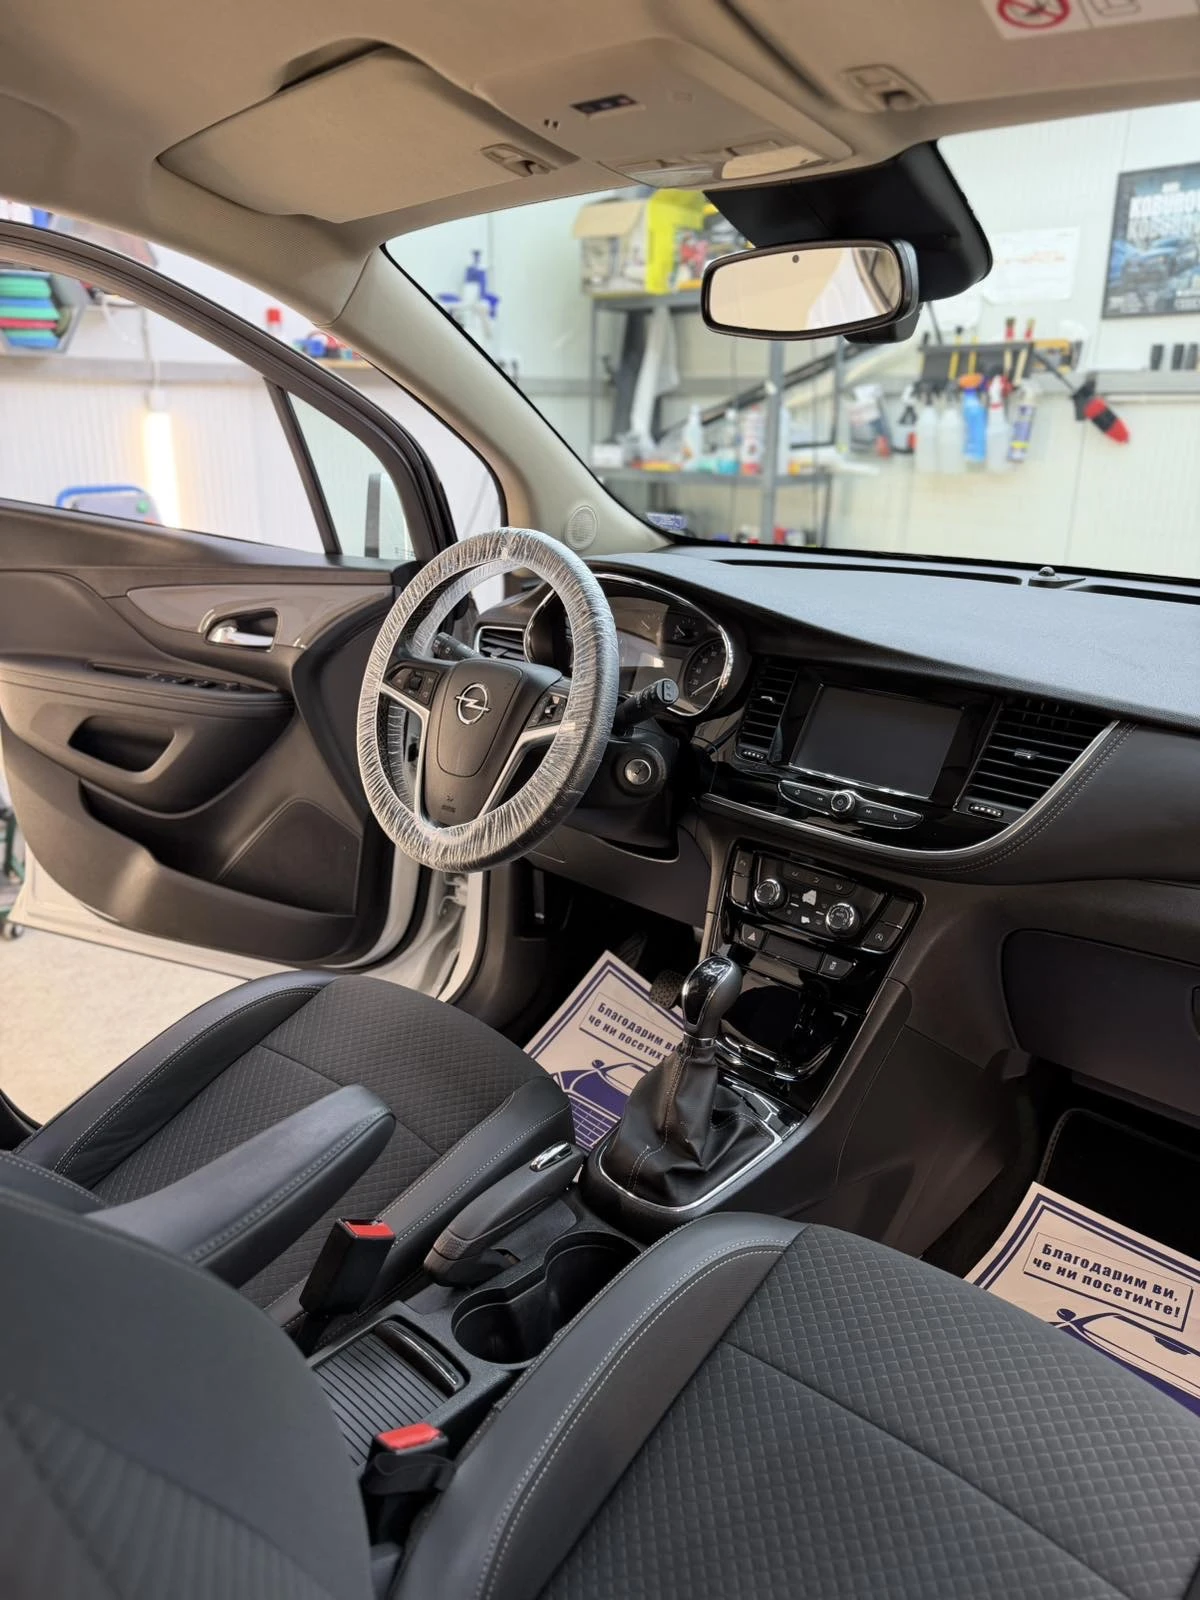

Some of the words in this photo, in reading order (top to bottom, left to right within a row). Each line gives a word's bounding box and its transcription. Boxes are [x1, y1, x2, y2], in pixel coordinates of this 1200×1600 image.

[589, 1014, 602, 1027] че
[603, 1026, 617, 1037] ни
[618, 1033, 668, 1060] посетихт
[598, 1003, 664, 1045] Благодарим
[1033, 1257, 1051, 1271] че
[1056, 1265, 1077, 1280] ни
[1082, 1275, 1180, 1318] посетихте!
[1042, 1243, 1147, 1290] Благодарим
